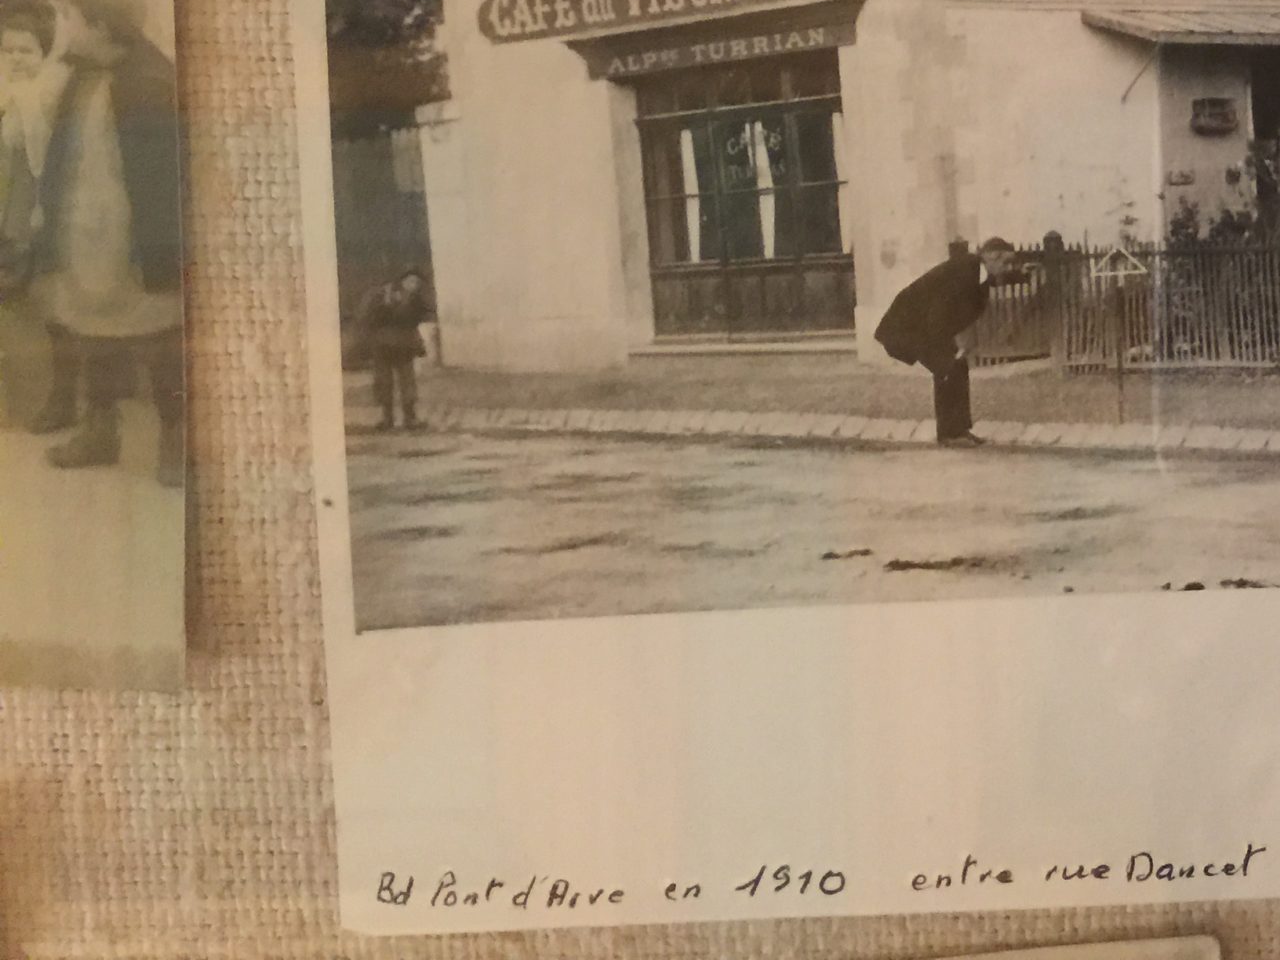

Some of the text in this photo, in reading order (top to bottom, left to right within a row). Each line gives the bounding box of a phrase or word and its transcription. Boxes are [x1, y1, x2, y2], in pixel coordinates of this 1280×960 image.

[690, 26, 825, 62] TURRIAN
[376, 871, 414, 904] Bd
[430, 871, 503, 908] Pont
[664, 881, 700, 900] en
[736, 864, 847, 898] 1910
[911, 854, 1013, 893] entre
[1045, 865, 1110, 882] rue
[1126, 843, 1267, 882] Dancet
